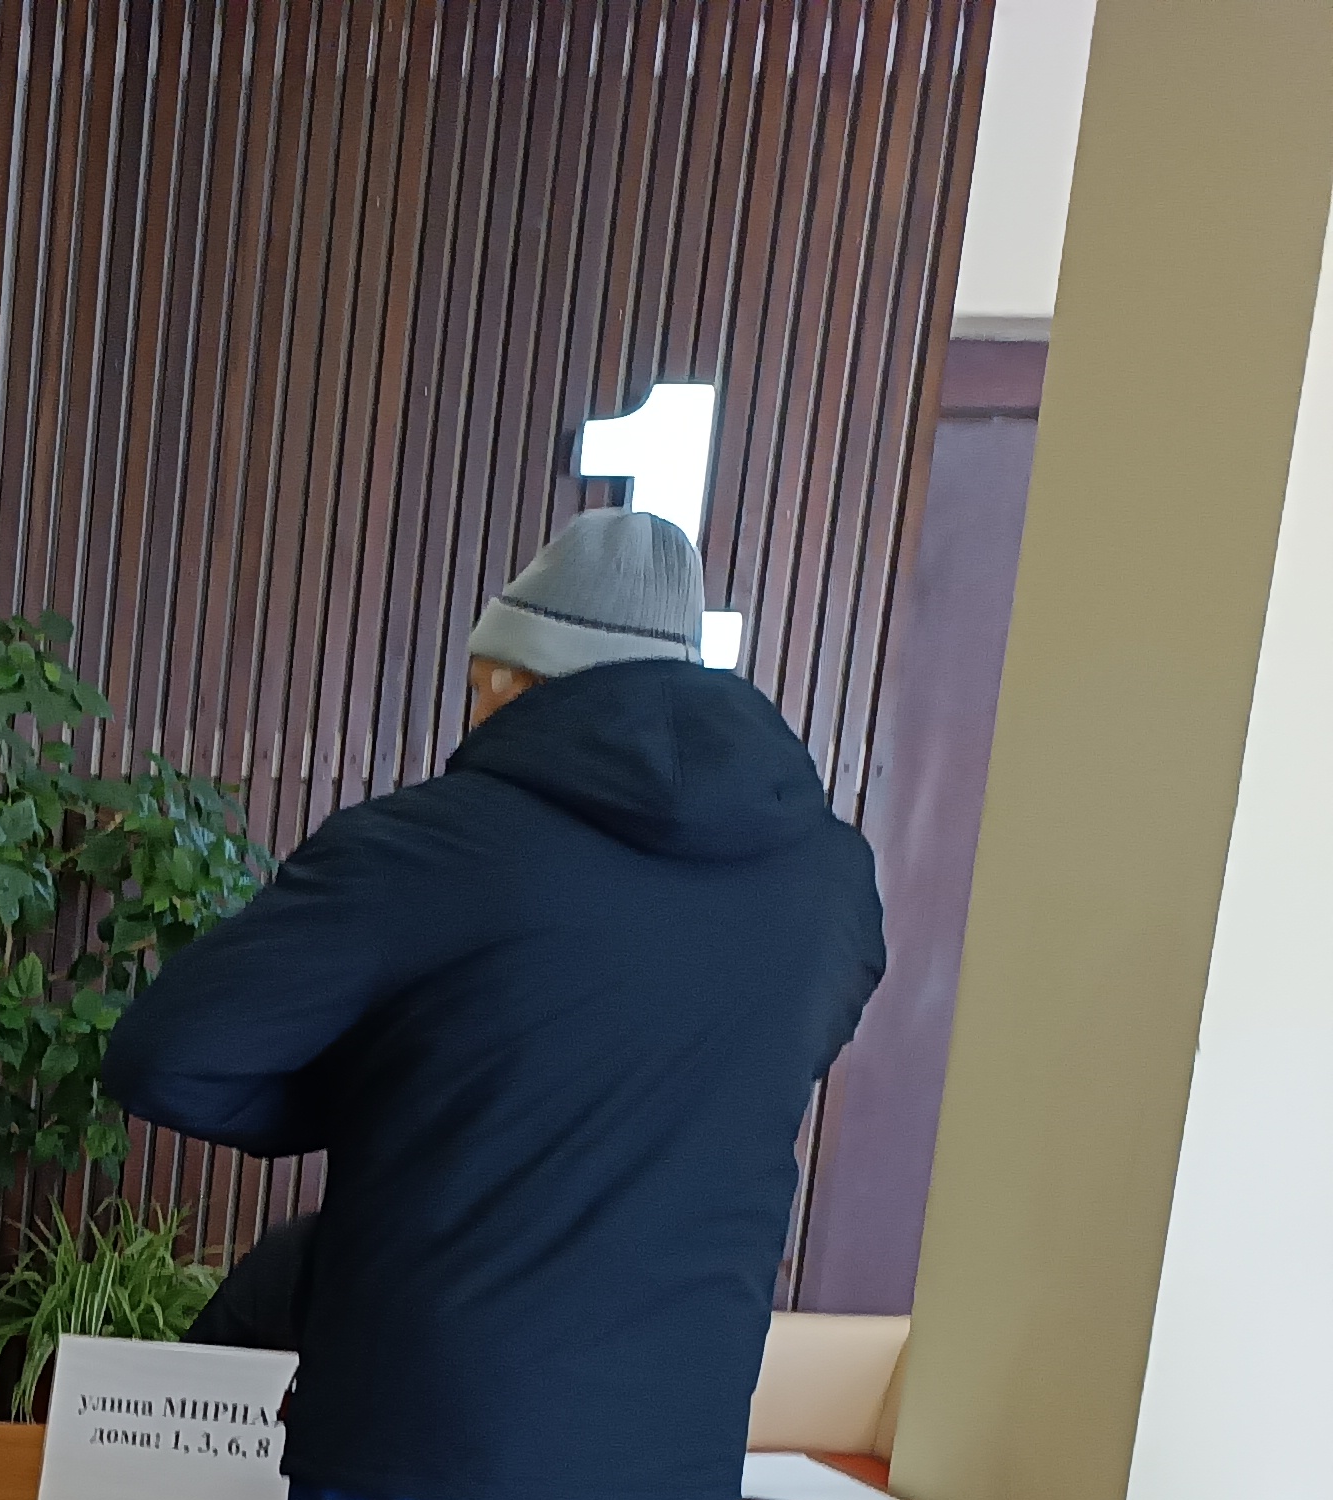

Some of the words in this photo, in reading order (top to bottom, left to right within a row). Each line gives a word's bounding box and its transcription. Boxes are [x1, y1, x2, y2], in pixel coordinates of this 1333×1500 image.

[78, 1393, 153, 1417] улица
[90, 1427, 161, 1449] дома:
[172, 1429, 190, 1454] 1,
[197, 1430, 218, 1457] 3,
[227, 1435, 247, 1459] 6,
